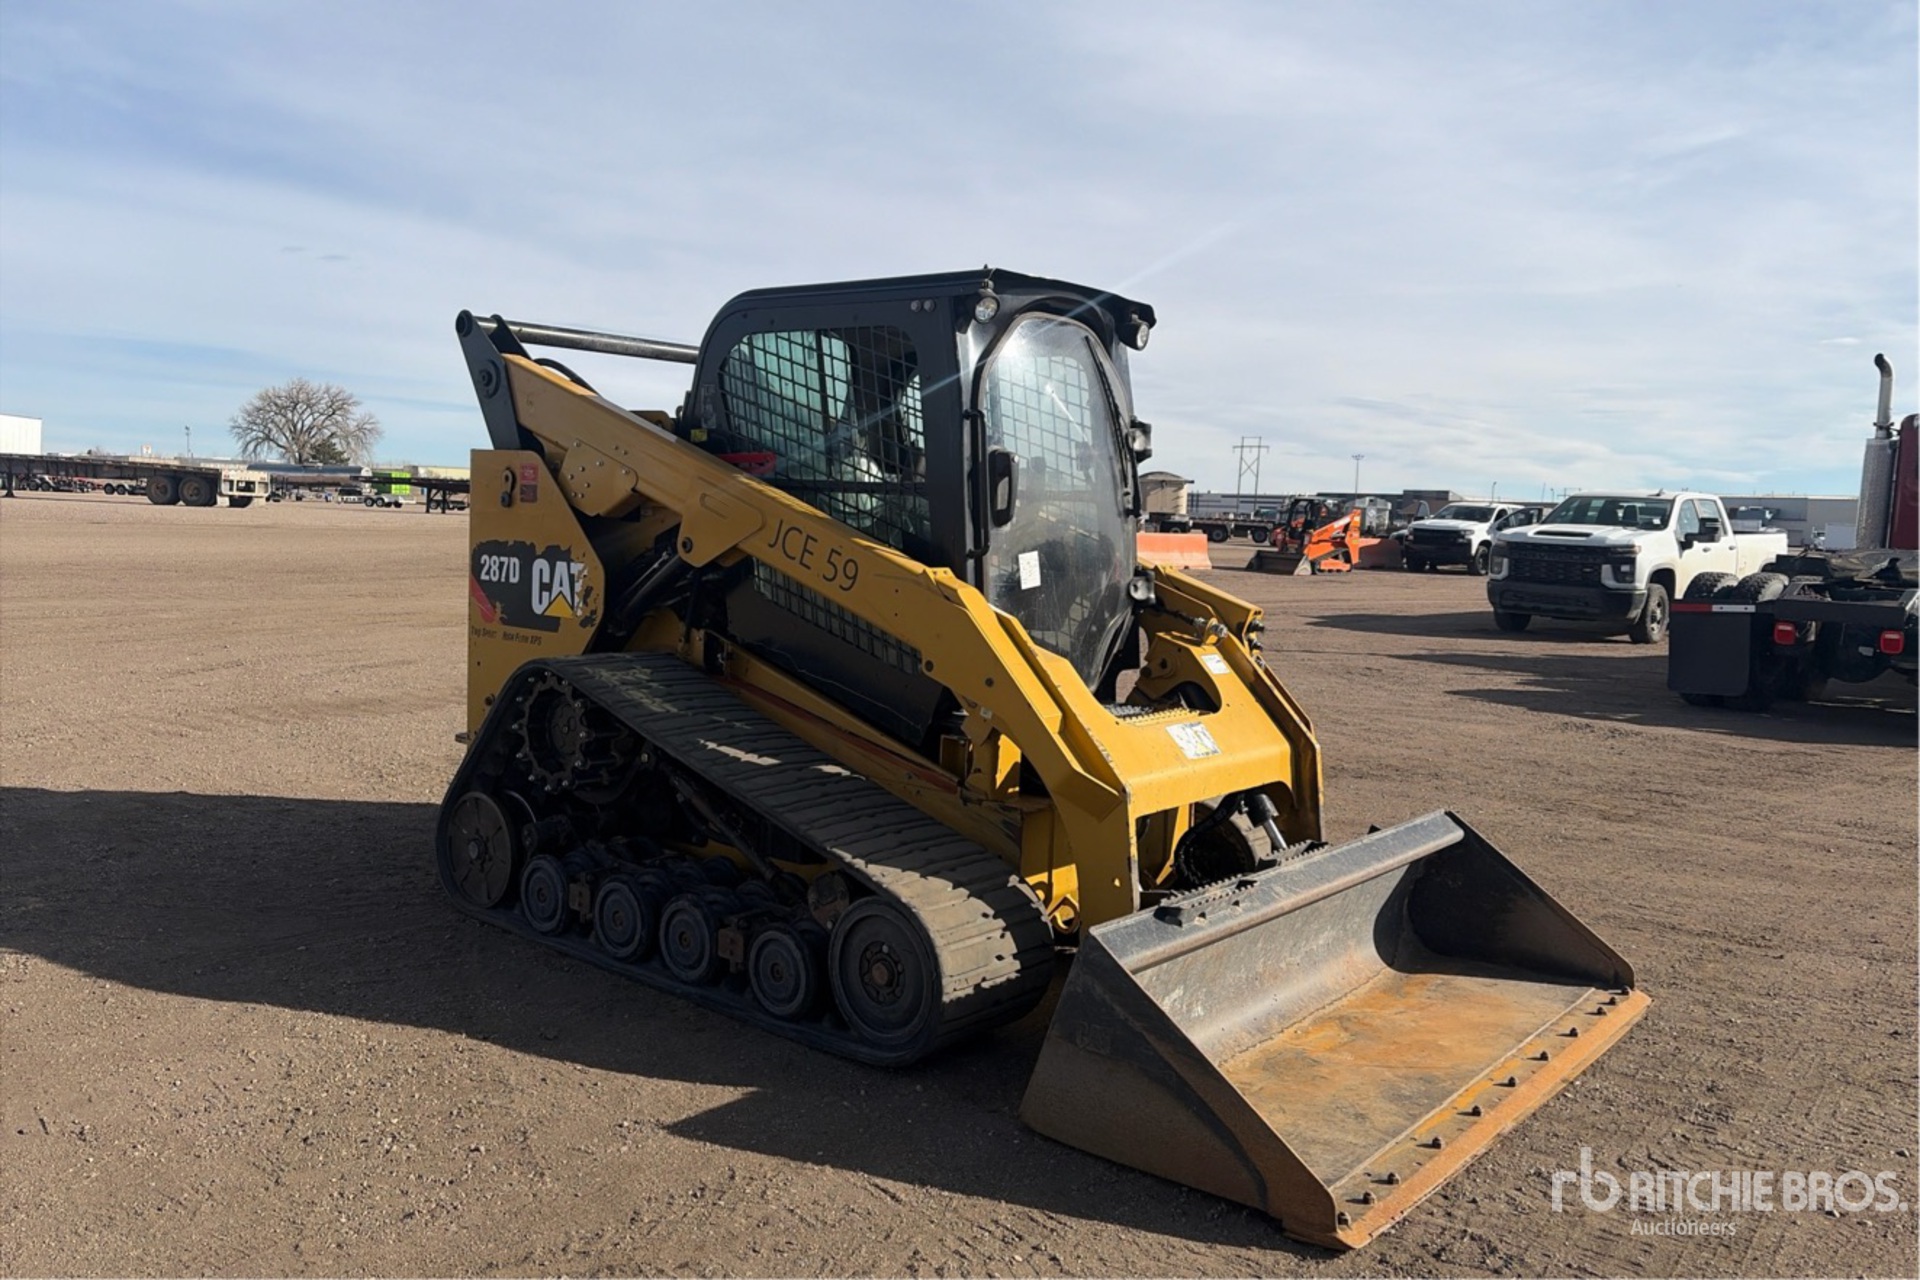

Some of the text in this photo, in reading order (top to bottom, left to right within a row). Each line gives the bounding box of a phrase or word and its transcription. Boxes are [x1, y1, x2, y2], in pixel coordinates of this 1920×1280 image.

[480, 554, 520, 584] 287D
[767, 518, 859, 592] JCE 59
[532, 558, 588, 617] CAT
